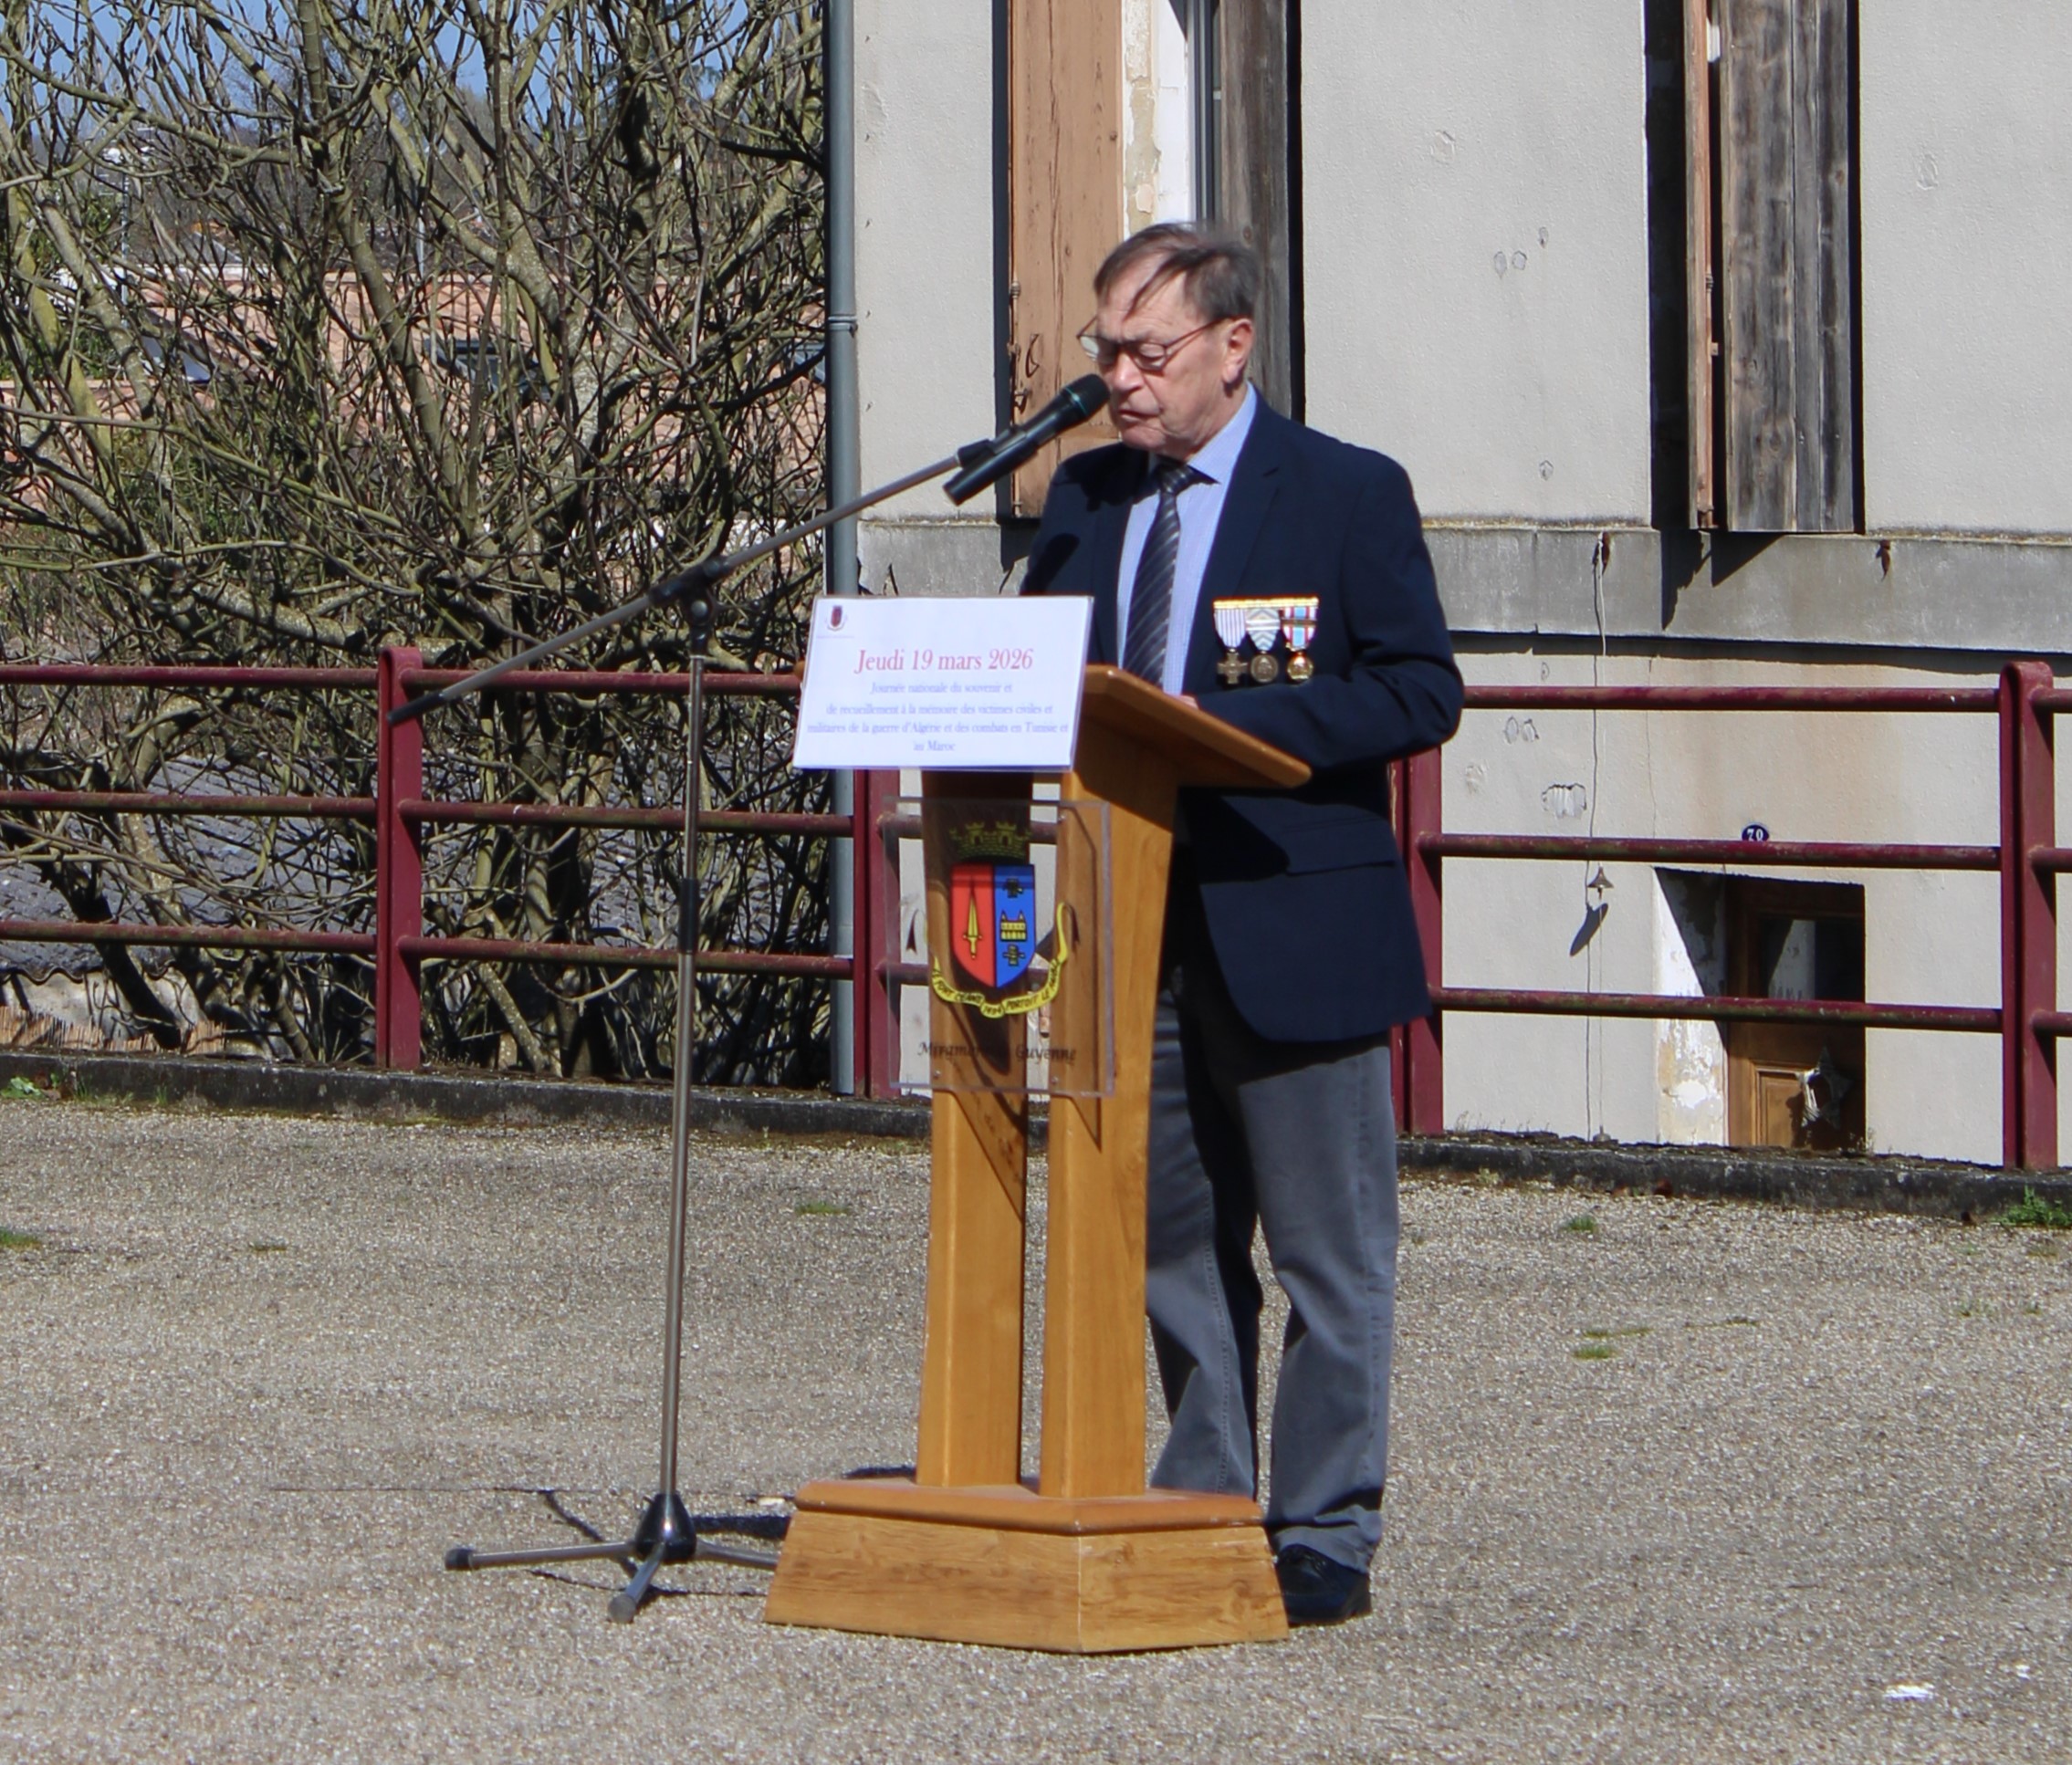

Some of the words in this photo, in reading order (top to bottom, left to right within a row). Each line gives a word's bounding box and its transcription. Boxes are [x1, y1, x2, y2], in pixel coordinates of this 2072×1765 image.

[853, 649, 905, 674] Jeudi
[912, 649, 934, 671] 19
[937, 655, 982, 671] mars
[989, 649, 1033, 670] 2026
[869, 682, 906, 695] Journée
[907, 681, 949, 694] nationale
[950, 682, 962, 694] du
[964, 682, 1002, 694] souvenir
[1003, 684, 1013, 694] et
[825, 703, 838, 715] de
[840, 703, 899, 715] recueillement
[900, 704, 907, 715] à
[908, 703, 917, 715] la
[918, 703, 958, 715] mémoire
[959, 703, 977, 715] des
[978, 704, 1013, 715] victimes
[1015, 703, 1043, 715] civiles
[1043, 705, 1053, 715] et
[806, 721, 847, 733] militaires
[848, 721, 861, 733] de
[861, 721, 870, 733] la
[871, 724, 901, 736] guerre
[943, 723, 954, 733] et
[954, 721, 969, 733] des
[971, 721, 1010, 733] combats
[1010, 725, 1022, 733] en
[1023, 721, 1058, 733] Tunisie
[1059, 723, 1069, 733] et
[914, 742, 926, 752] au
[926, 739, 957, 752] Maroc
[1746, 828, 1764, 841] 70
